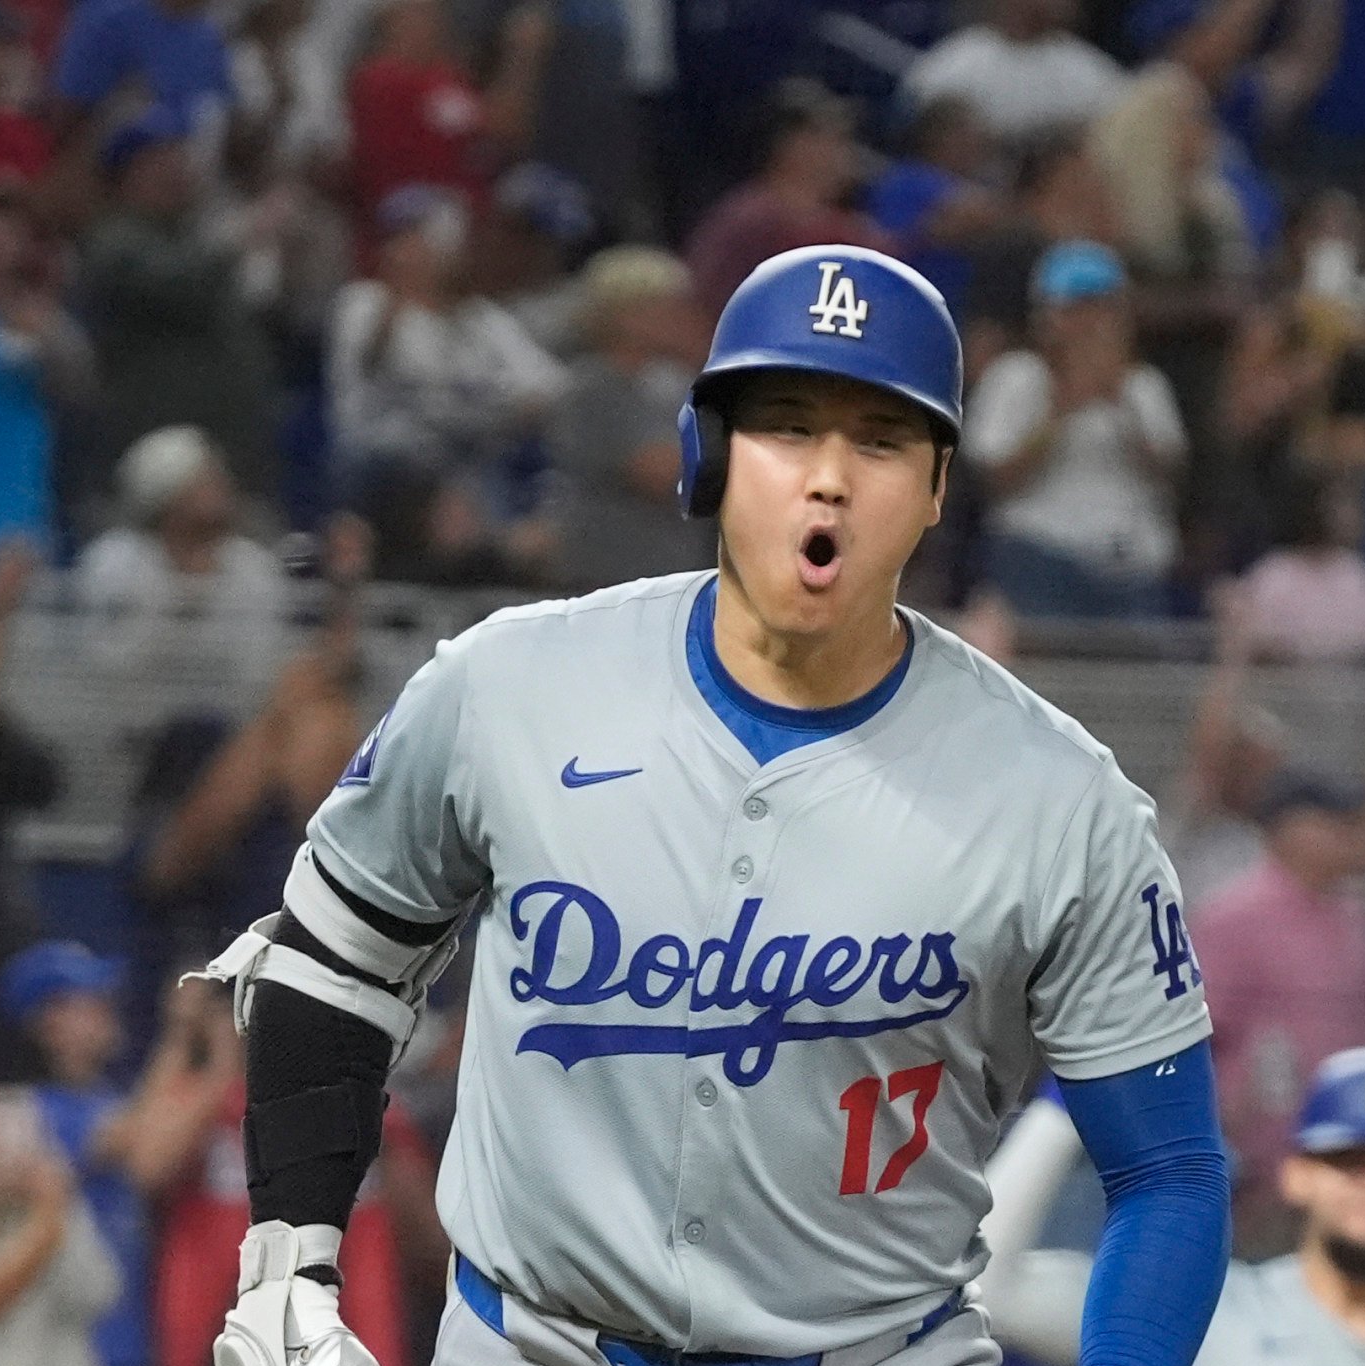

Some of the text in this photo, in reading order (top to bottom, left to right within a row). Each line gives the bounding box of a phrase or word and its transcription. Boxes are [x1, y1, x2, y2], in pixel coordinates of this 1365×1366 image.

[808, 261, 868, 338] LA
[510, 880, 969, 1087] Dodgers
[839, 1059, 945, 1196] 17
